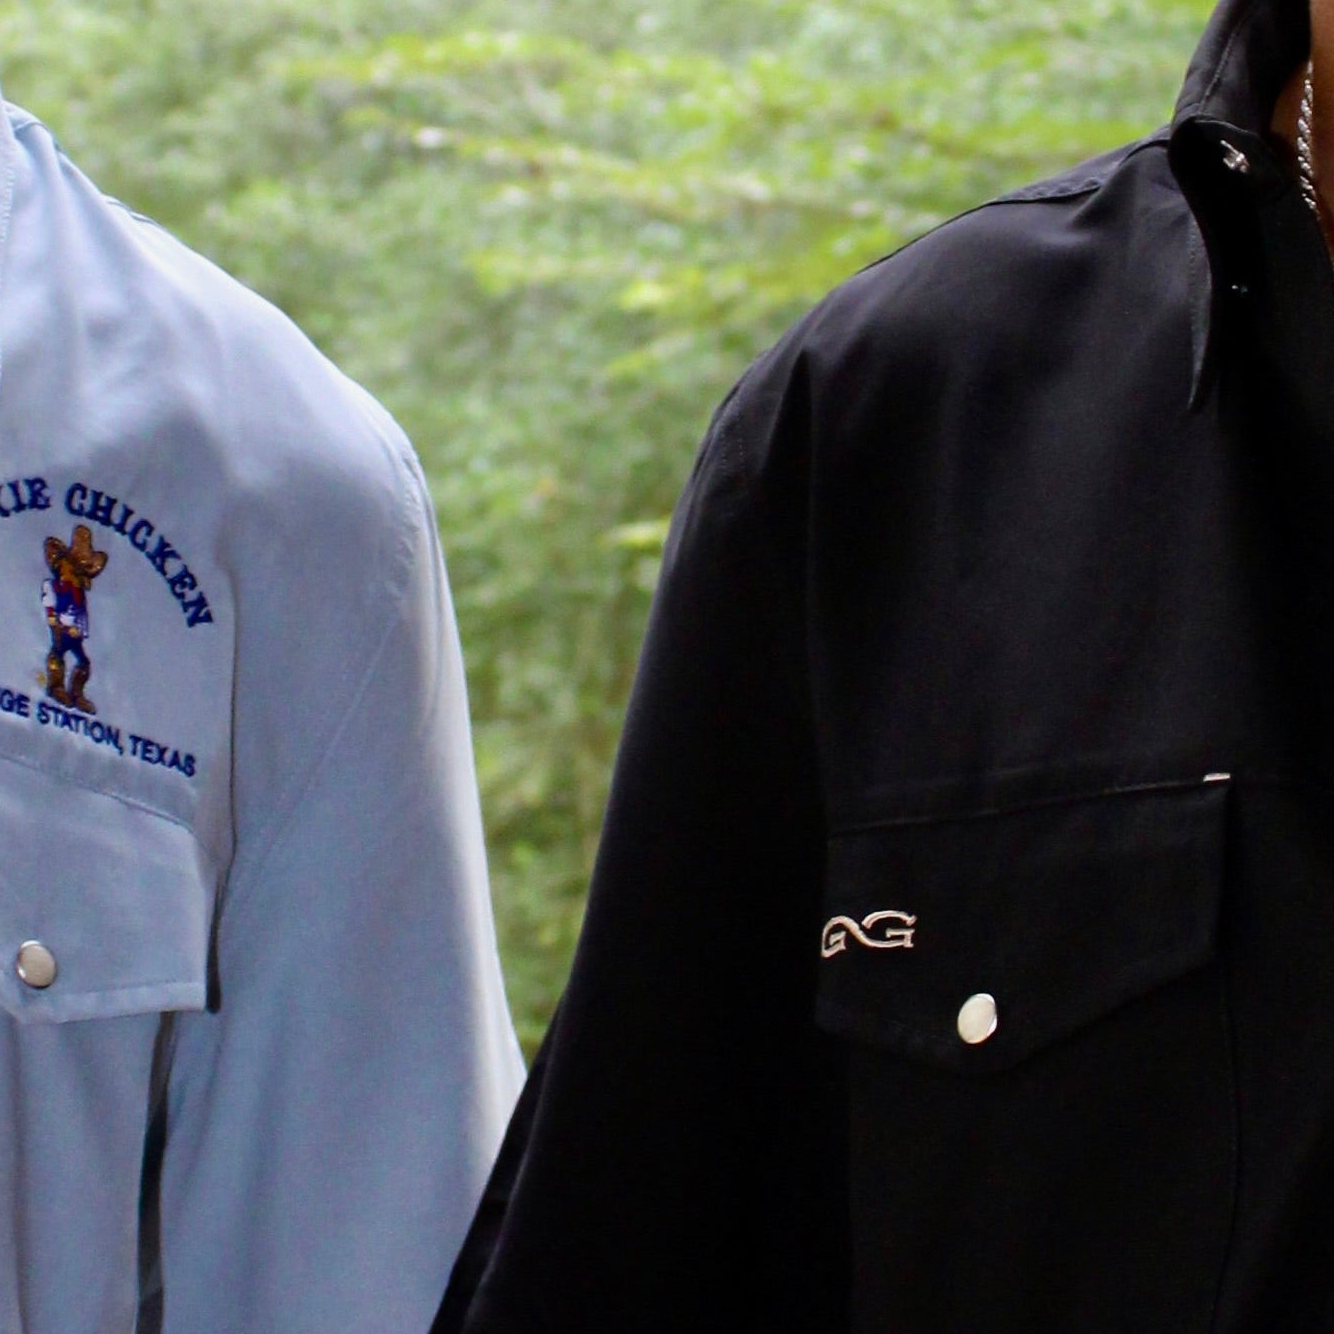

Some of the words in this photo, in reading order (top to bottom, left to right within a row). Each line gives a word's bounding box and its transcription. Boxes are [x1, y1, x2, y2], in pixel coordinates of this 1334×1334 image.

[63, 482, 214, 628] CHICKEN
[36, 702, 124, 756] STATION,
[128, 733, 197, 778] TEXAS
